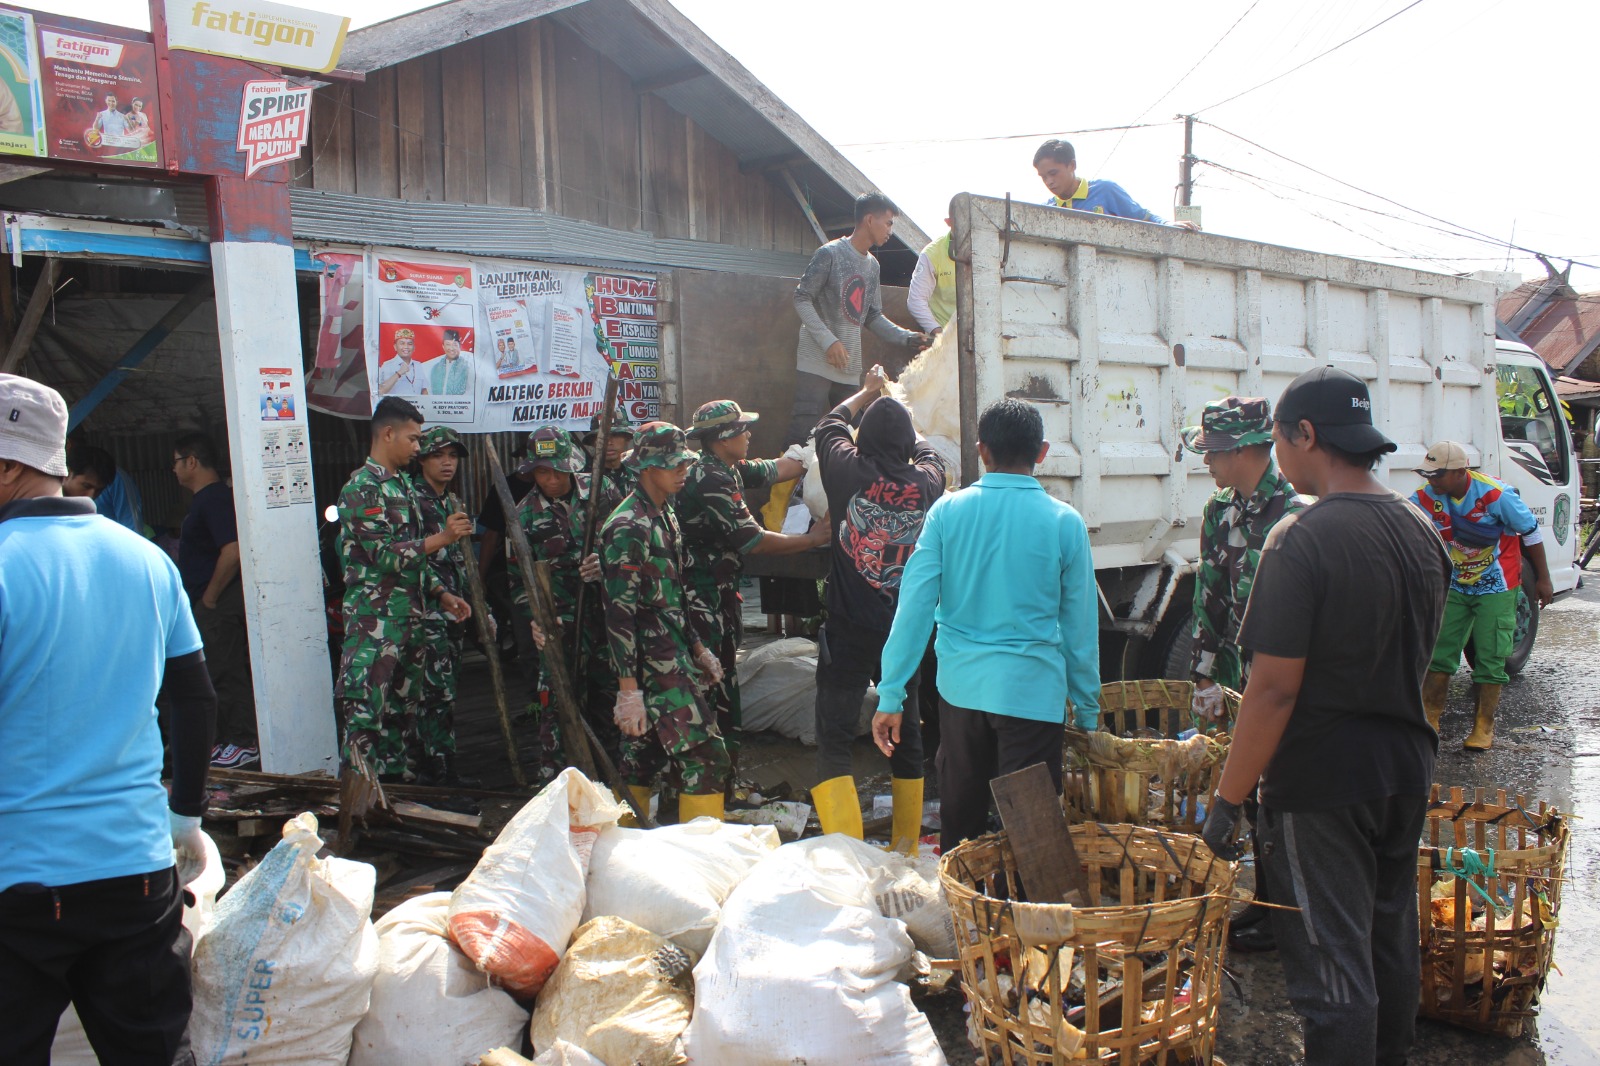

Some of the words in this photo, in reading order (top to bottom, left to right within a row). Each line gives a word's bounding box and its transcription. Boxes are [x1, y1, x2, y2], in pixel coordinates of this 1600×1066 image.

[191, 1, 315, 48] fatigon
[258, 13, 287, 23] SUPLEMEN
[55, 50, 90, 61] SPIRIT
[56, 37, 110, 56] fatigon
[53, 64, 84, 75] Membantu
[118, 74, 142, 84] Stamina,
[54, 71, 75, 80] Tenaga
[87, 76, 117, 86] Kesegaran
[251, 86, 281, 95] fatigon
[247, 92, 308, 120] SPIRIT
[248, 115, 300, 141] MERAH
[256, 140, 292, 160] PUTIH
[496, 283, 528, 296] LEBIH
[530, 279, 561, 293] BAIK!
[423, 306, 433, 320] 3
[600, 296, 654, 316] BANTUAN
[617, 362, 657, 380] AKSES
[488, 383, 544, 402] KALTENG
[547, 381, 593, 399] BERKAH
[512, 403, 568, 422] KALTENG
[237, 958, 276, 1040] SUPER
